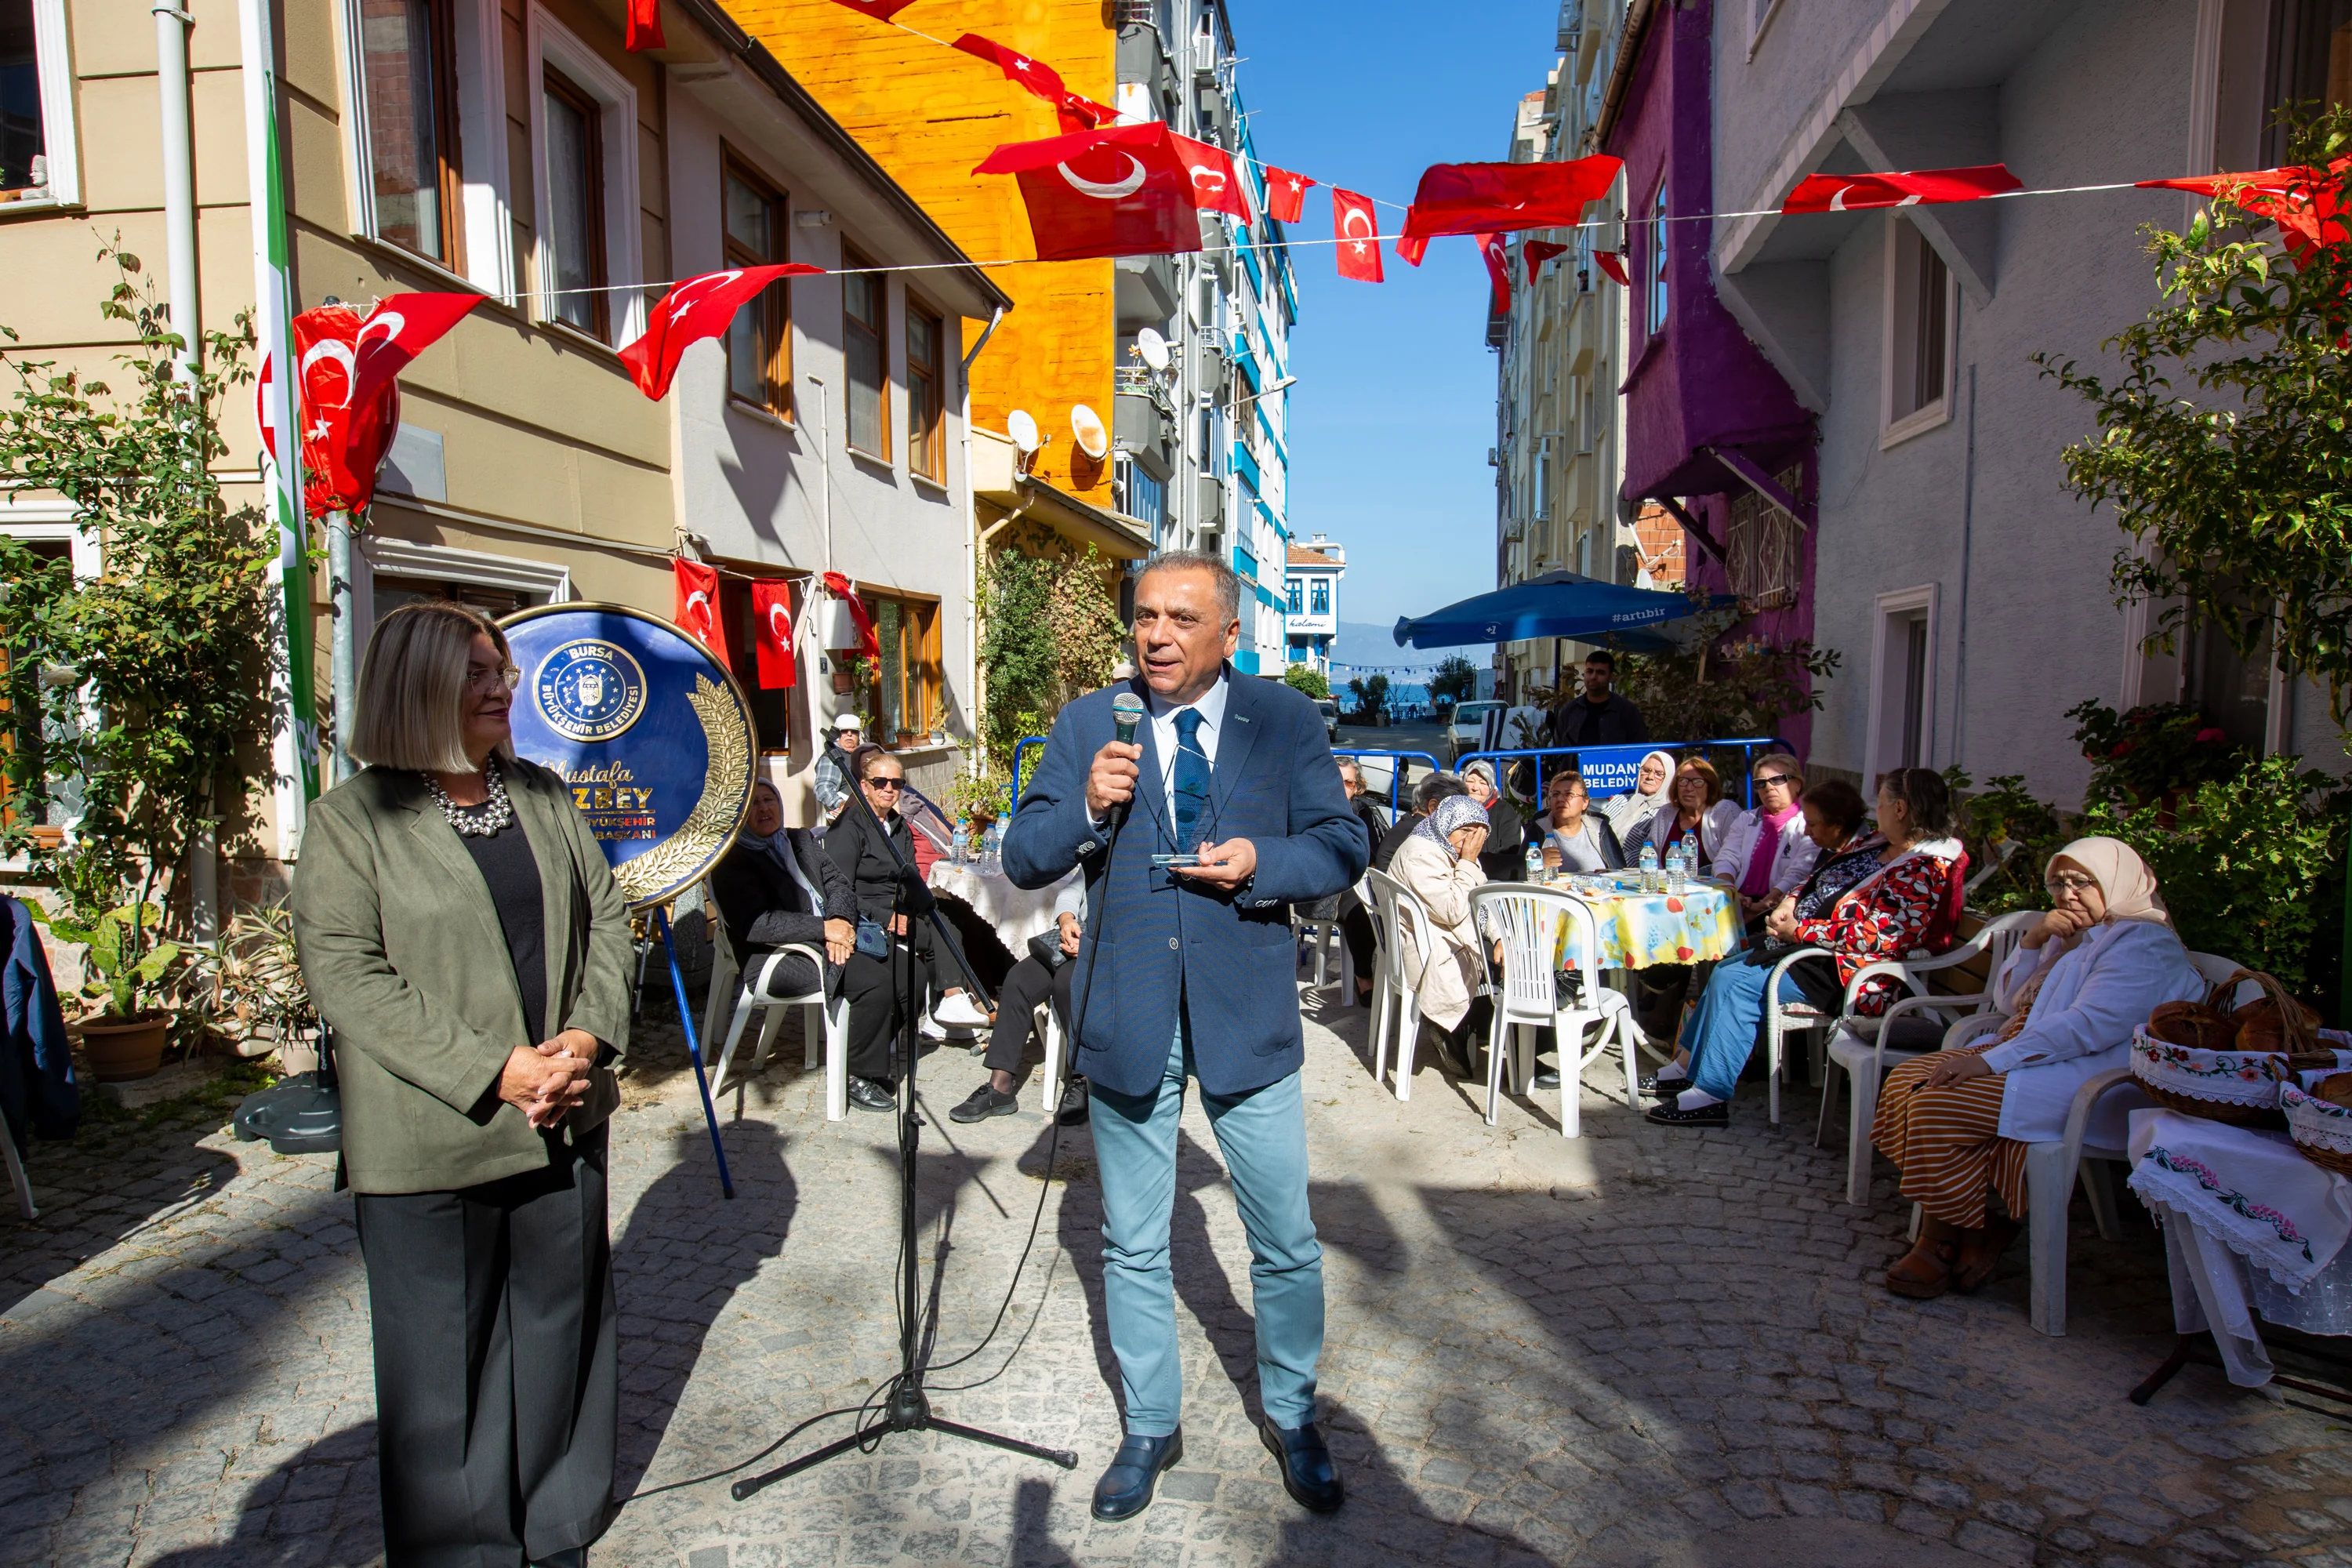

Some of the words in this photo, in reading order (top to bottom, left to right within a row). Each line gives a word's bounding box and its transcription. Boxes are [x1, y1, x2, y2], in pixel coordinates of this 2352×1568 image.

[1612, 608, 1666, 622] #artıbir
[1486, 625, 1497, 634] +1
[568, 646, 613, 660] BURSA
[542, 684, 593, 734] BÜYÜKŞEHİR
[596, 685, 638, 734] BELEDİYESİ
[539, 758, 633, 789] Mustafa
[1583, 763, 1640, 775] MUDAN
[595, 830, 656, 843] BAŞKANI
